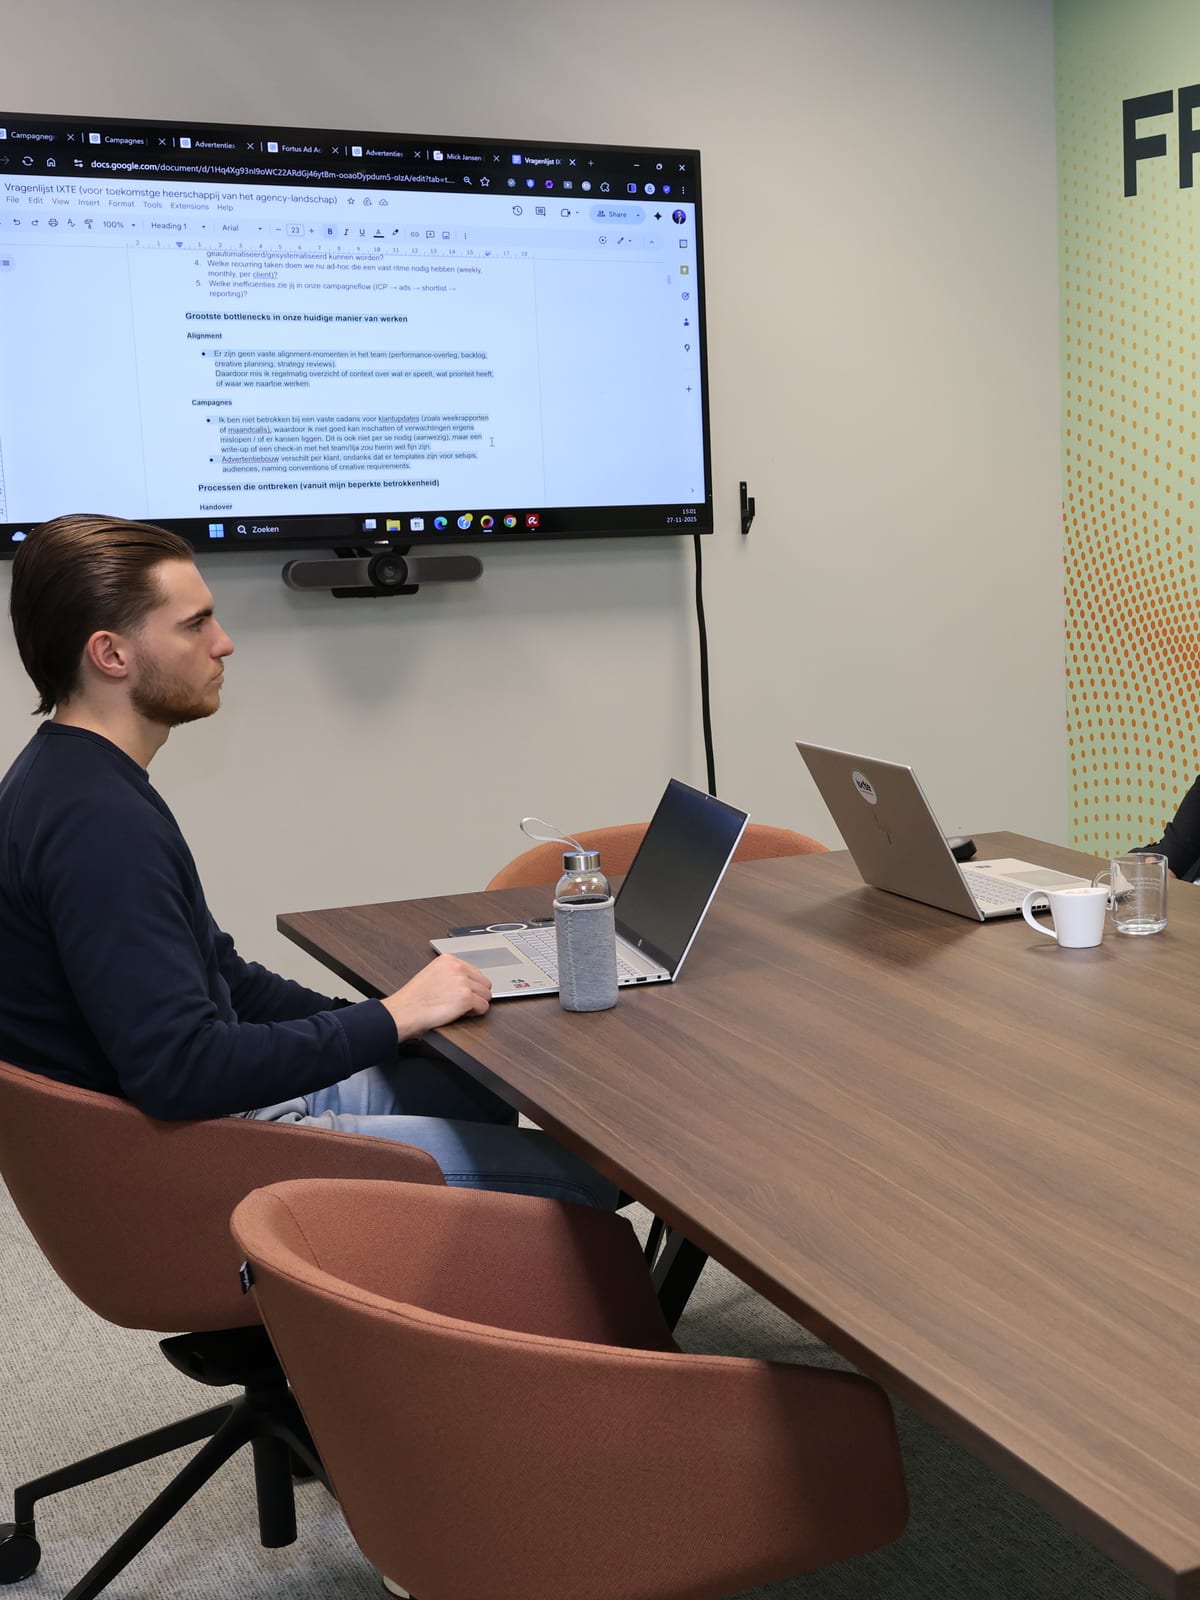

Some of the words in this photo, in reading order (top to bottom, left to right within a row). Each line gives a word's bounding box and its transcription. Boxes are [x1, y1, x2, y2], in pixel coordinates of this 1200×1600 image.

[4, 183, 54, 194] Vragenlijst
[56, 185, 77, 193] IXTE
[79, 185, 103, 195] (voor
[163, 189, 220, 201] heerschappij
[239, 192, 254, 200] het
[28, 196, 43, 204] Edit
[170, 202, 209, 210] Extensions
[217, 204, 234, 212] Help
[152, 222, 182, 231] Heading
[185, 312, 221, 320] Grootste
[303, 314, 334, 322] huidige
[335, 314, 362, 322] manier
[191, 399, 232, 407] Campagnes
[198, 483, 241, 491] Processen
[243, 483, 256, 491] die
[258, 482, 298, 490] ontbreken
[329, 482, 346, 490] mijn
[348, 481, 382, 489] beperkte
[252, 525, 280, 533] Zoeken
